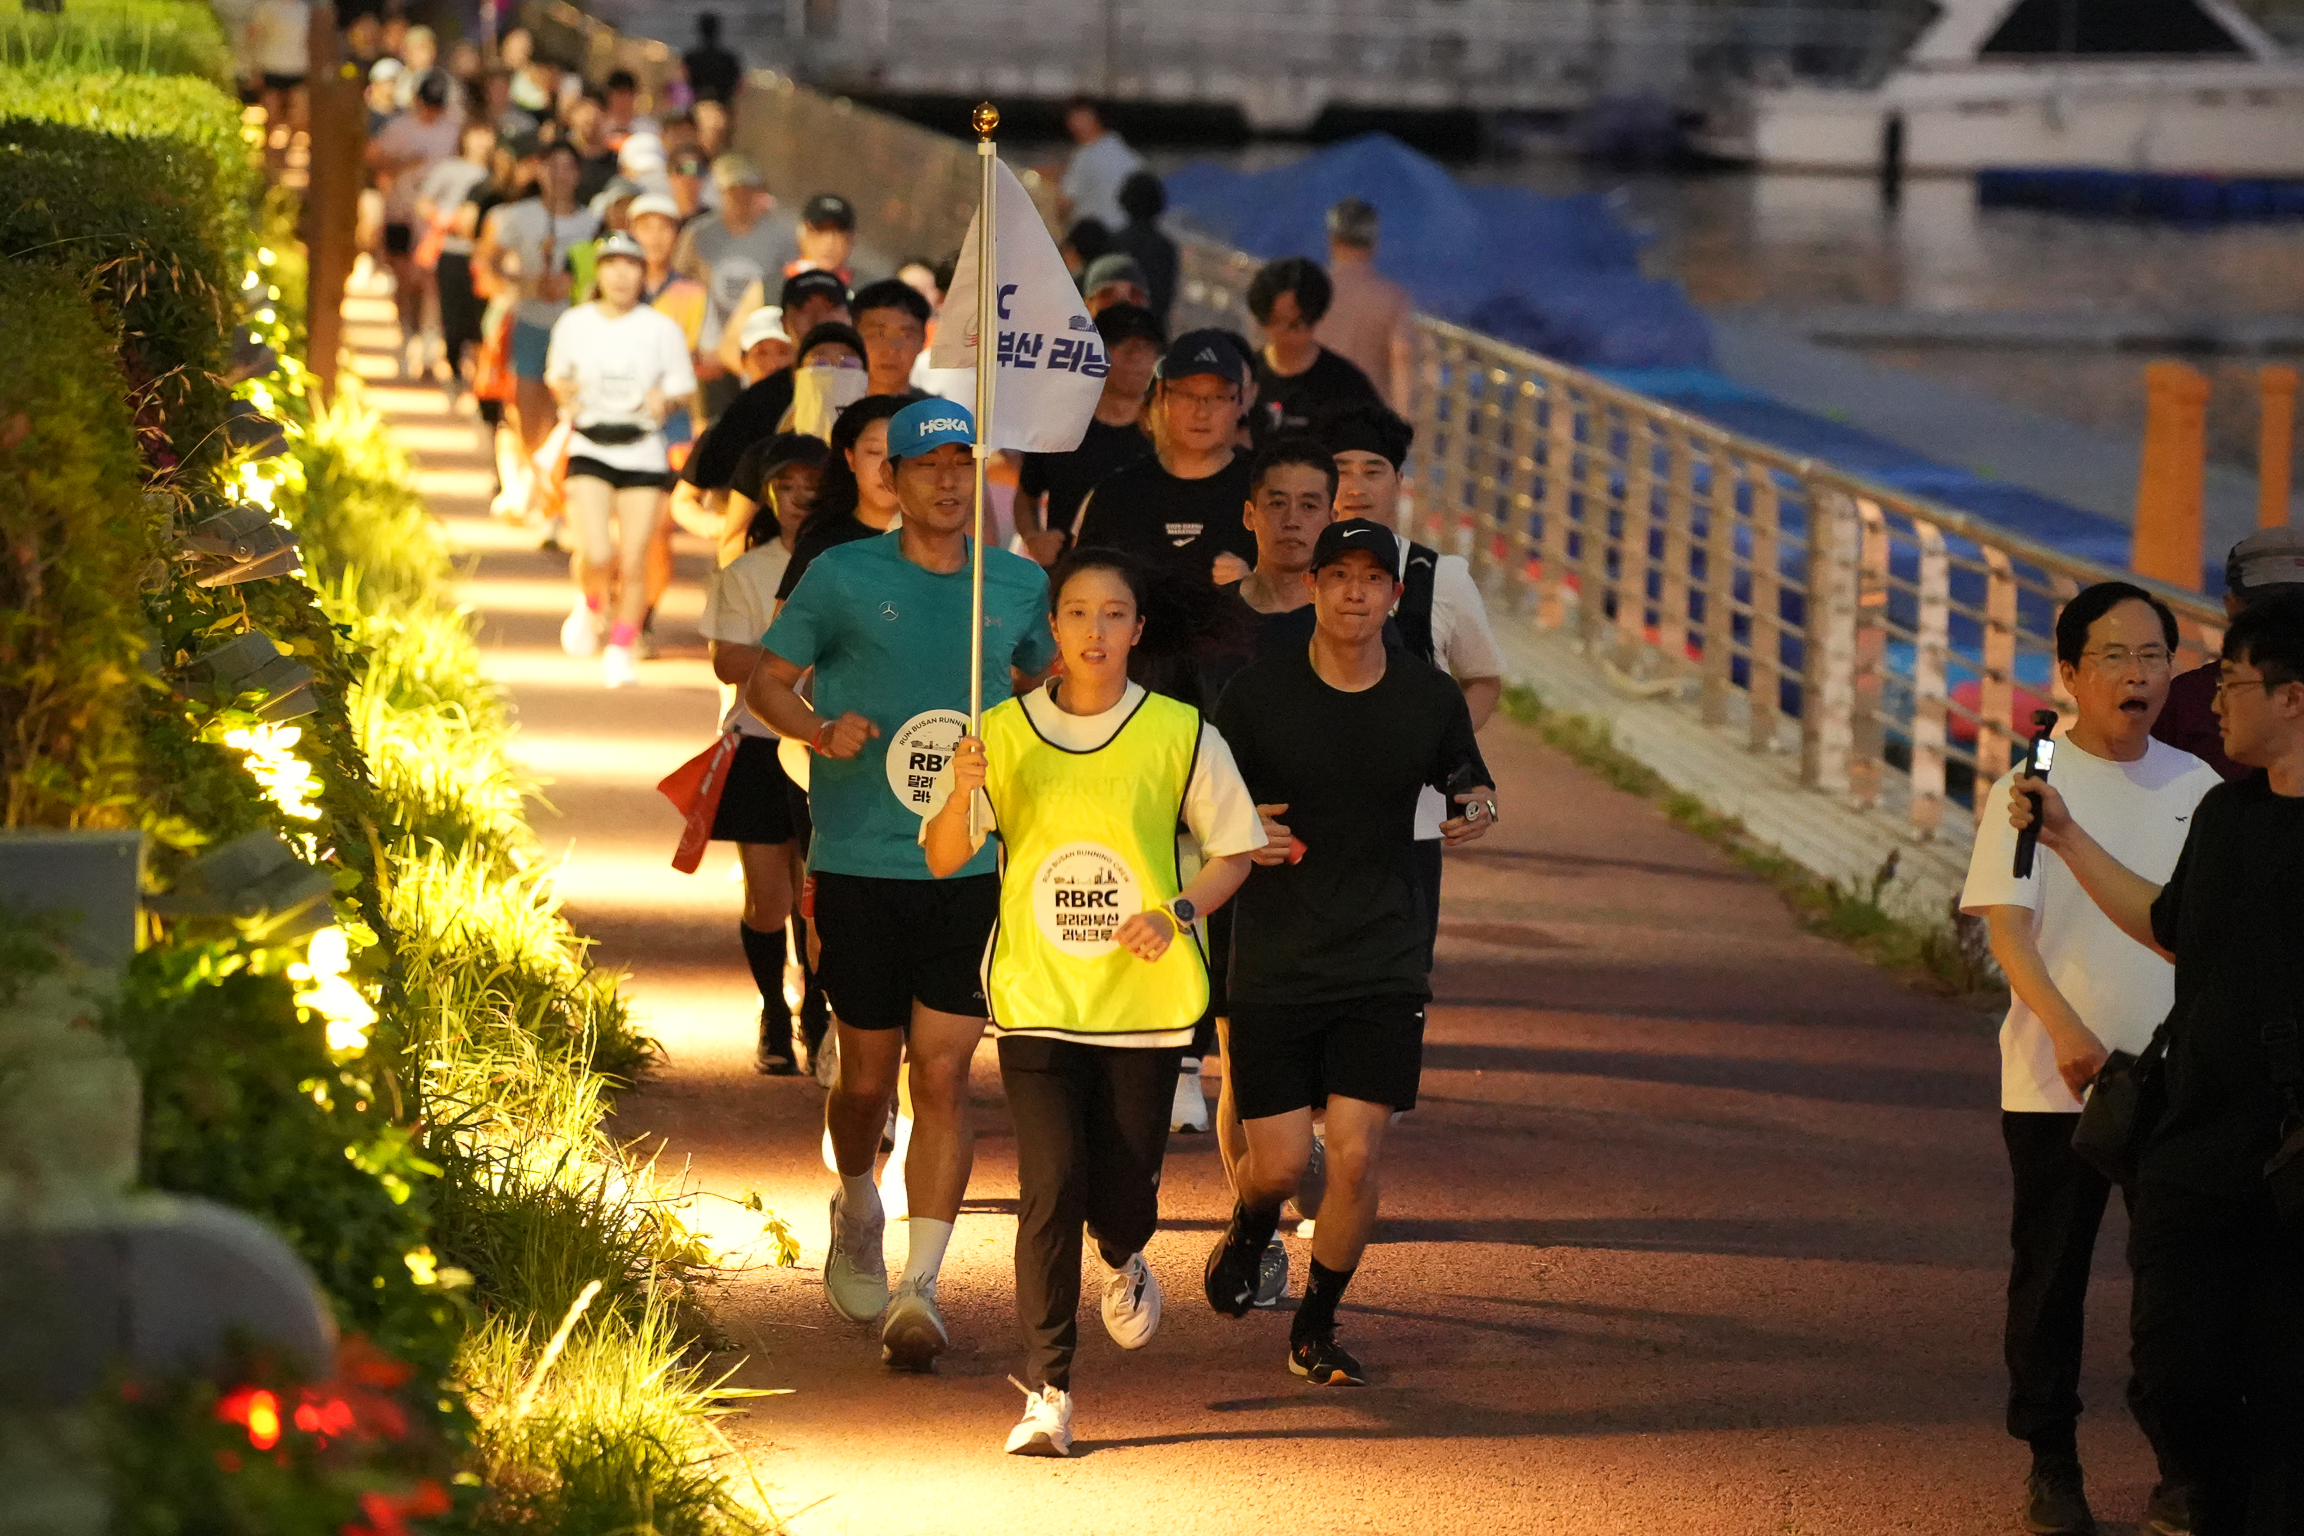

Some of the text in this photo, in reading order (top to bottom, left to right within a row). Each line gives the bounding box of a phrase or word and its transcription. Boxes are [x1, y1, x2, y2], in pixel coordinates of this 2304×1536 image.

[920, 418, 969, 437] HOKA
[899, 716, 963, 746] RUN BUSAN RUNNI
[908, 774, 936, 789] 달려
[1052, 851, 1075, 868] BUSAN
[1076, 849, 1112, 863] RUNNING
[1055, 889, 1119, 908] RBRC
